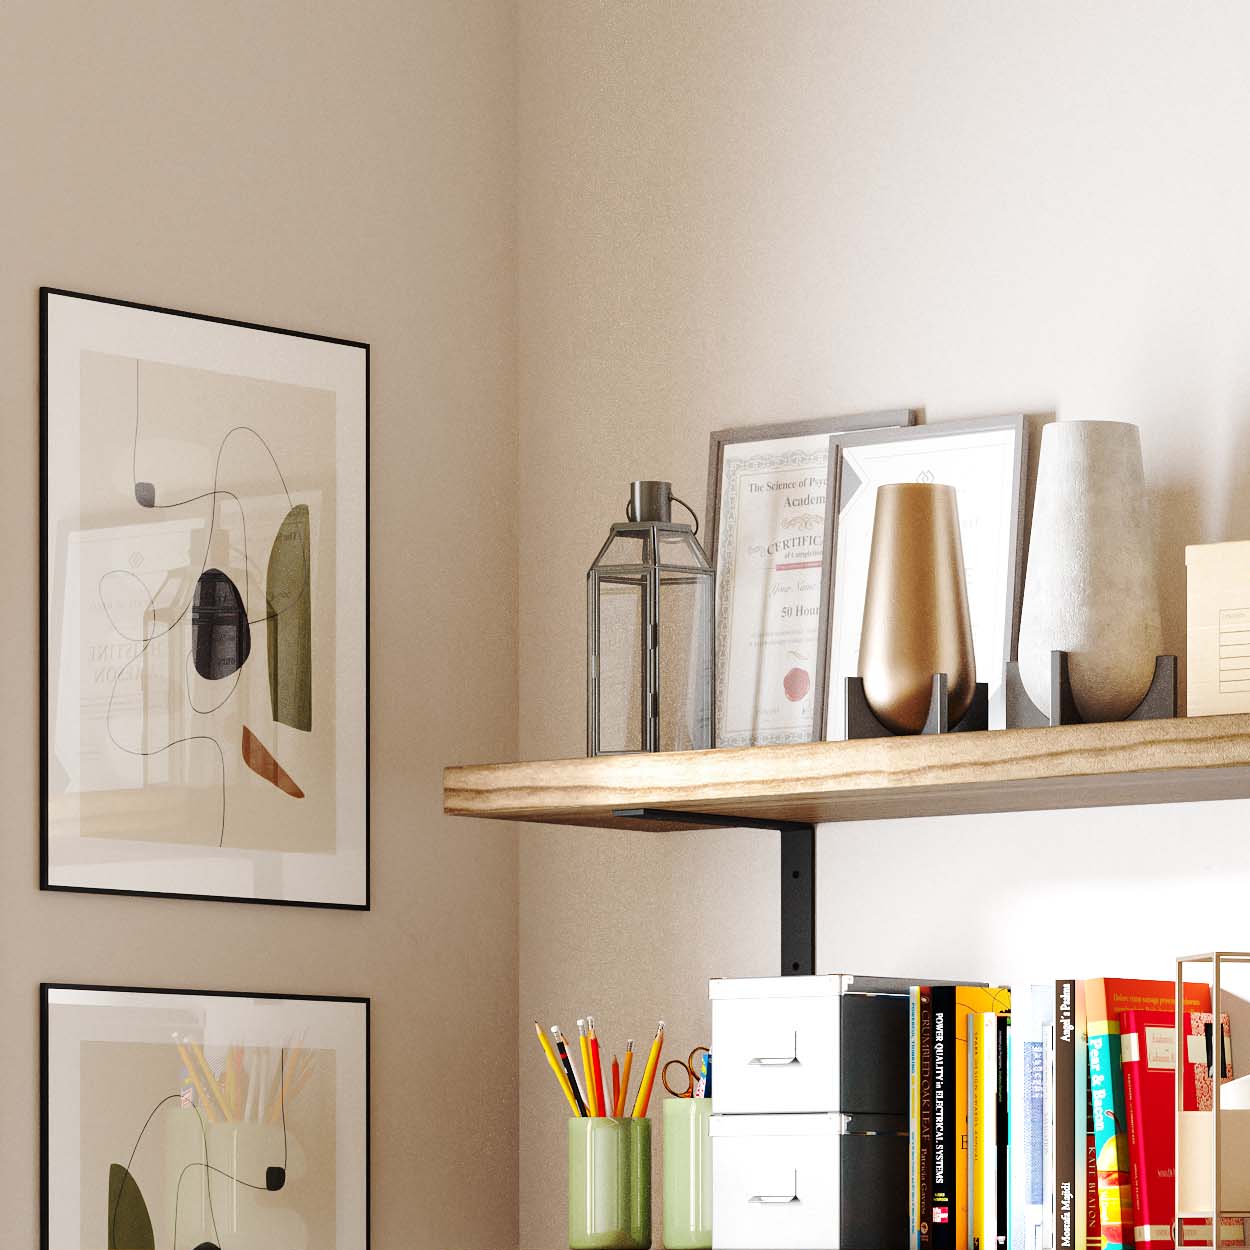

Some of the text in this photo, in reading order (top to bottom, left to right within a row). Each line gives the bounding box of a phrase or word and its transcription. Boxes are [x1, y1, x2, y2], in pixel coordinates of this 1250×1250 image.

[749, 482, 763, 494] The
[766, 480, 797, 492] Science
[798, 477, 808, 489] of
[781, 605, 793, 619] 50
[921, 1010, 930, 1077] CRUMBLED
[935, 1012, 944, 1042] POWER
[934, 1042, 944, 1081] QUALITY
[921, 1079, 930, 1106] OAK
[1089, 1037, 1107, 1132] Pear & Bacon
[921, 1111, 931, 1142] LEAF
[935, 1090, 944, 1143] ELECTRICAL
[935, 1145, 945, 1184] SYSTEMS
[1088, 1146, 1097, 1228] KATE BEATON
[1060, 1211, 1072, 1247] Mostafa
